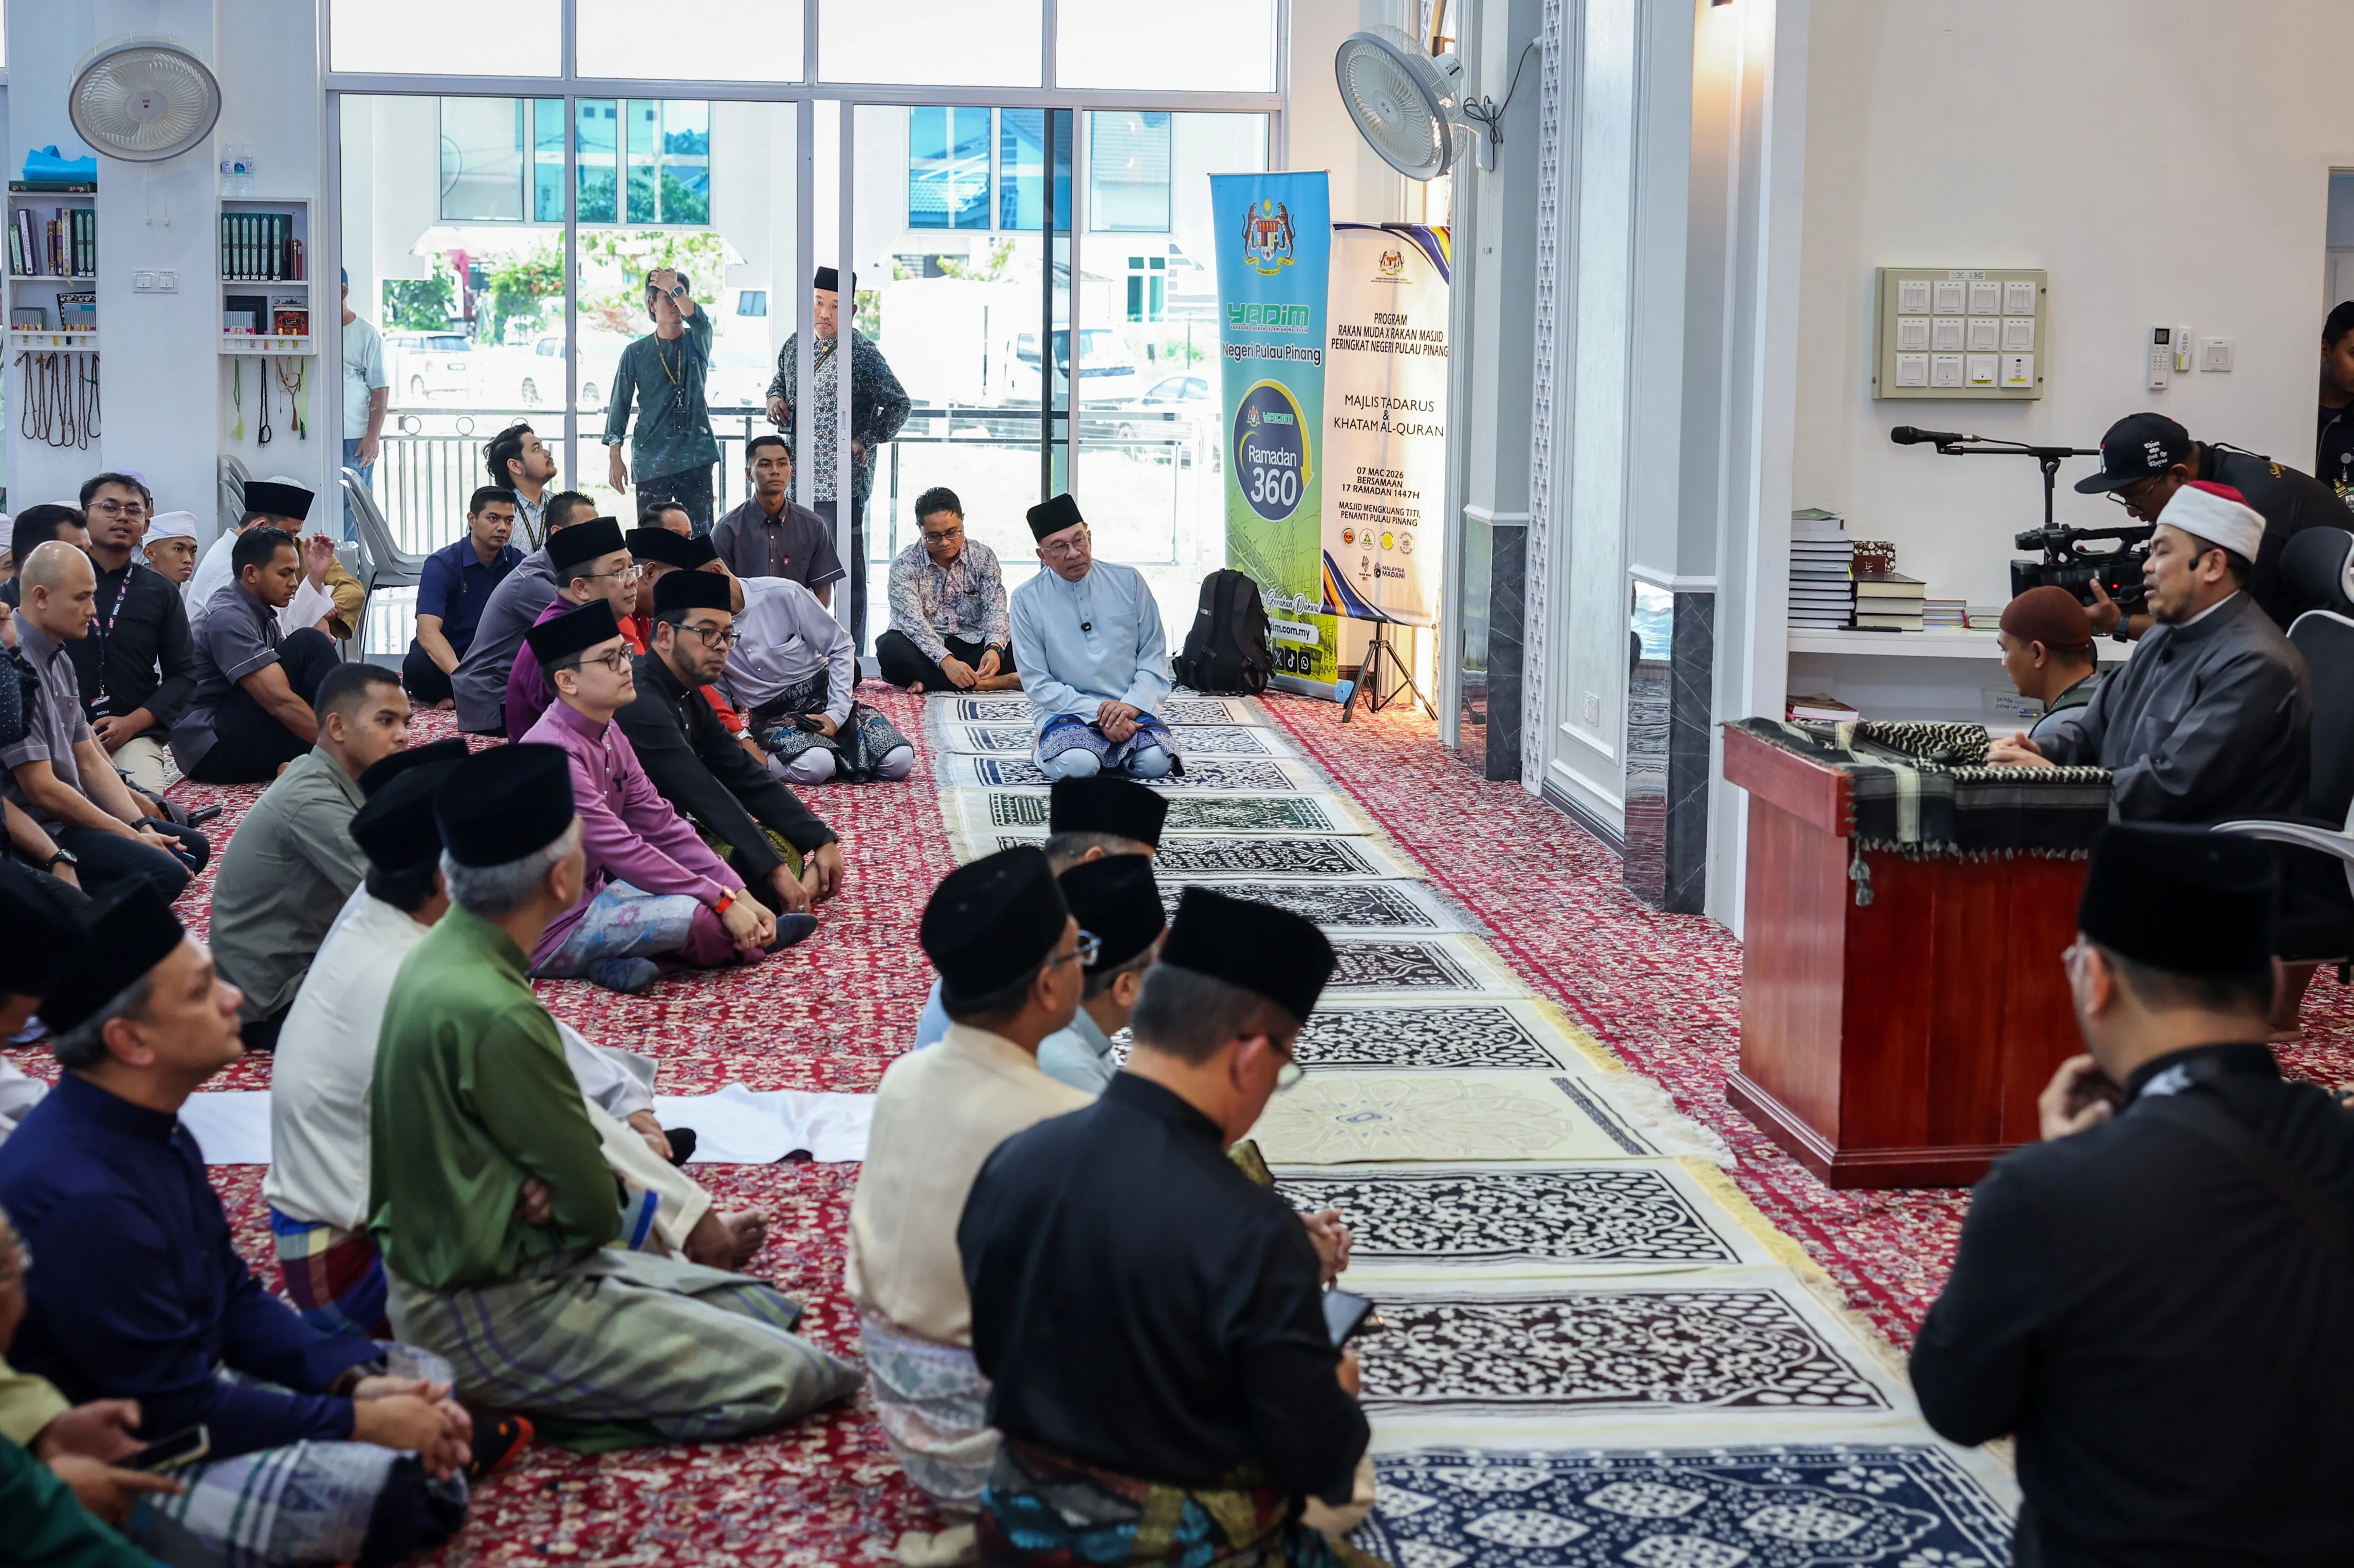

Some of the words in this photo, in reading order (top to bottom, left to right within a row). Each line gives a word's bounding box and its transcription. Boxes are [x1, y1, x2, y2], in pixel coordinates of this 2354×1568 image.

[1374, 313, 1407, 325] PROGRAM
[1338, 325, 1362, 337] RAKAN
[1364, 326, 1384, 338] MUDA
[1391, 328, 1417, 340] RAKAN
[1419, 329, 1443, 342] MASJID
[1223, 343, 1253, 361] Negeri
[1256, 344, 1282, 359] Pulau
[1286, 345, 1320, 365] Pinang
[1331, 339, 1368, 352] PERINGKAT
[1371, 340, 1393, 353] NEGERI
[1395, 341, 1421, 355] PULAU
[1423, 344, 1448, 357] PINANG
[1345, 394, 1378, 409] MAJLIS
[1382, 397, 1434, 412] TADARUS
[1383, 410, 1389, 420] &
[1334, 417, 1378, 432] KHATAM
[1381, 421, 1444, 437] AL-QURAN
[1248, 445, 1297, 467] Ramadan
[1357, 467, 1366, 475] 07
[1368, 468, 1384, 477] MAC
[1386, 470, 1404, 478] 2026
[1250, 467, 1297, 506] 360
[1357, 476, 1403, 488] BERSAMAAN
[1353, 485, 1391, 496] RAMADAN
[1394, 489, 1420, 499] 1447H
[1339, 501, 1362, 511] MASJID
[1364, 504, 1404, 516] MENGKUANG
[1406, 509, 1421, 519] TITI,
[1340, 511, 1368, 522] PENANTI
[1370, 513, 1391, 523] PULAU
[1392, 516, 1418, 526] PINANG
[1382, 570, 1405, 579] MADANI
[1266, 590, 1293, 611] Gerakan
[113, 603, 121, 616] MEDIA
